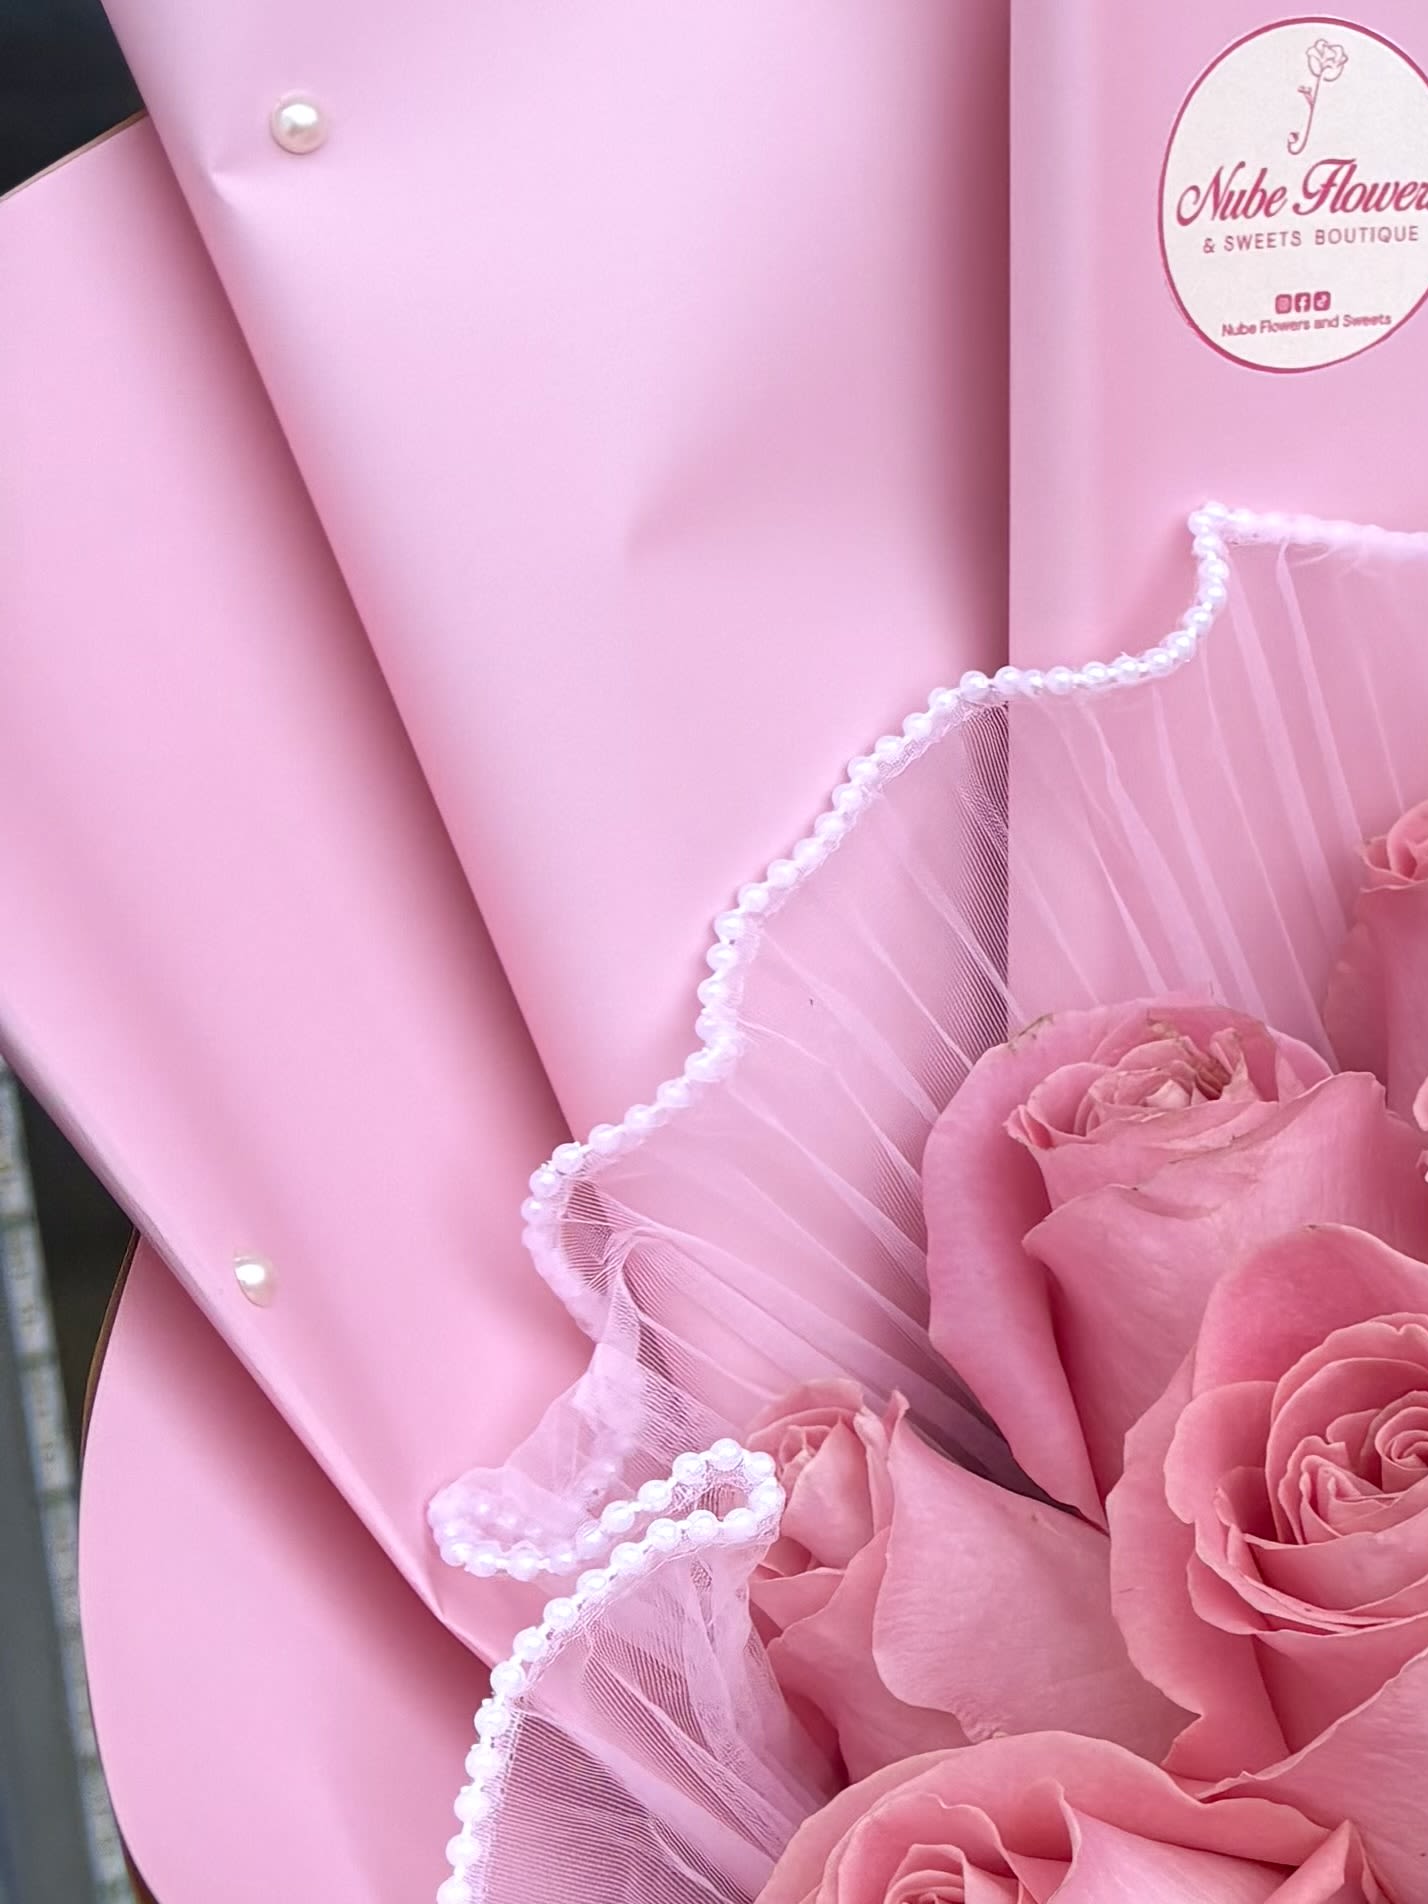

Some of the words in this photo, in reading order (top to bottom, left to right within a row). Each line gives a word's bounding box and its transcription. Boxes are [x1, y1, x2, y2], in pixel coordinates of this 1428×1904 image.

[1176, 160, 1288, 227] Nube
[1202, 237, 1216, 254] &
[1223, 230, 1303, 252] SWEETS
[1314, 225, 1420, 246] BOUTIQUE
[1221, 321, 1257, 337] Nube
[1259, 316, 1310, 335] Flowers
[1313, 315, 1340, 332] and
[1342, 312, 1393, 330] Sweets
